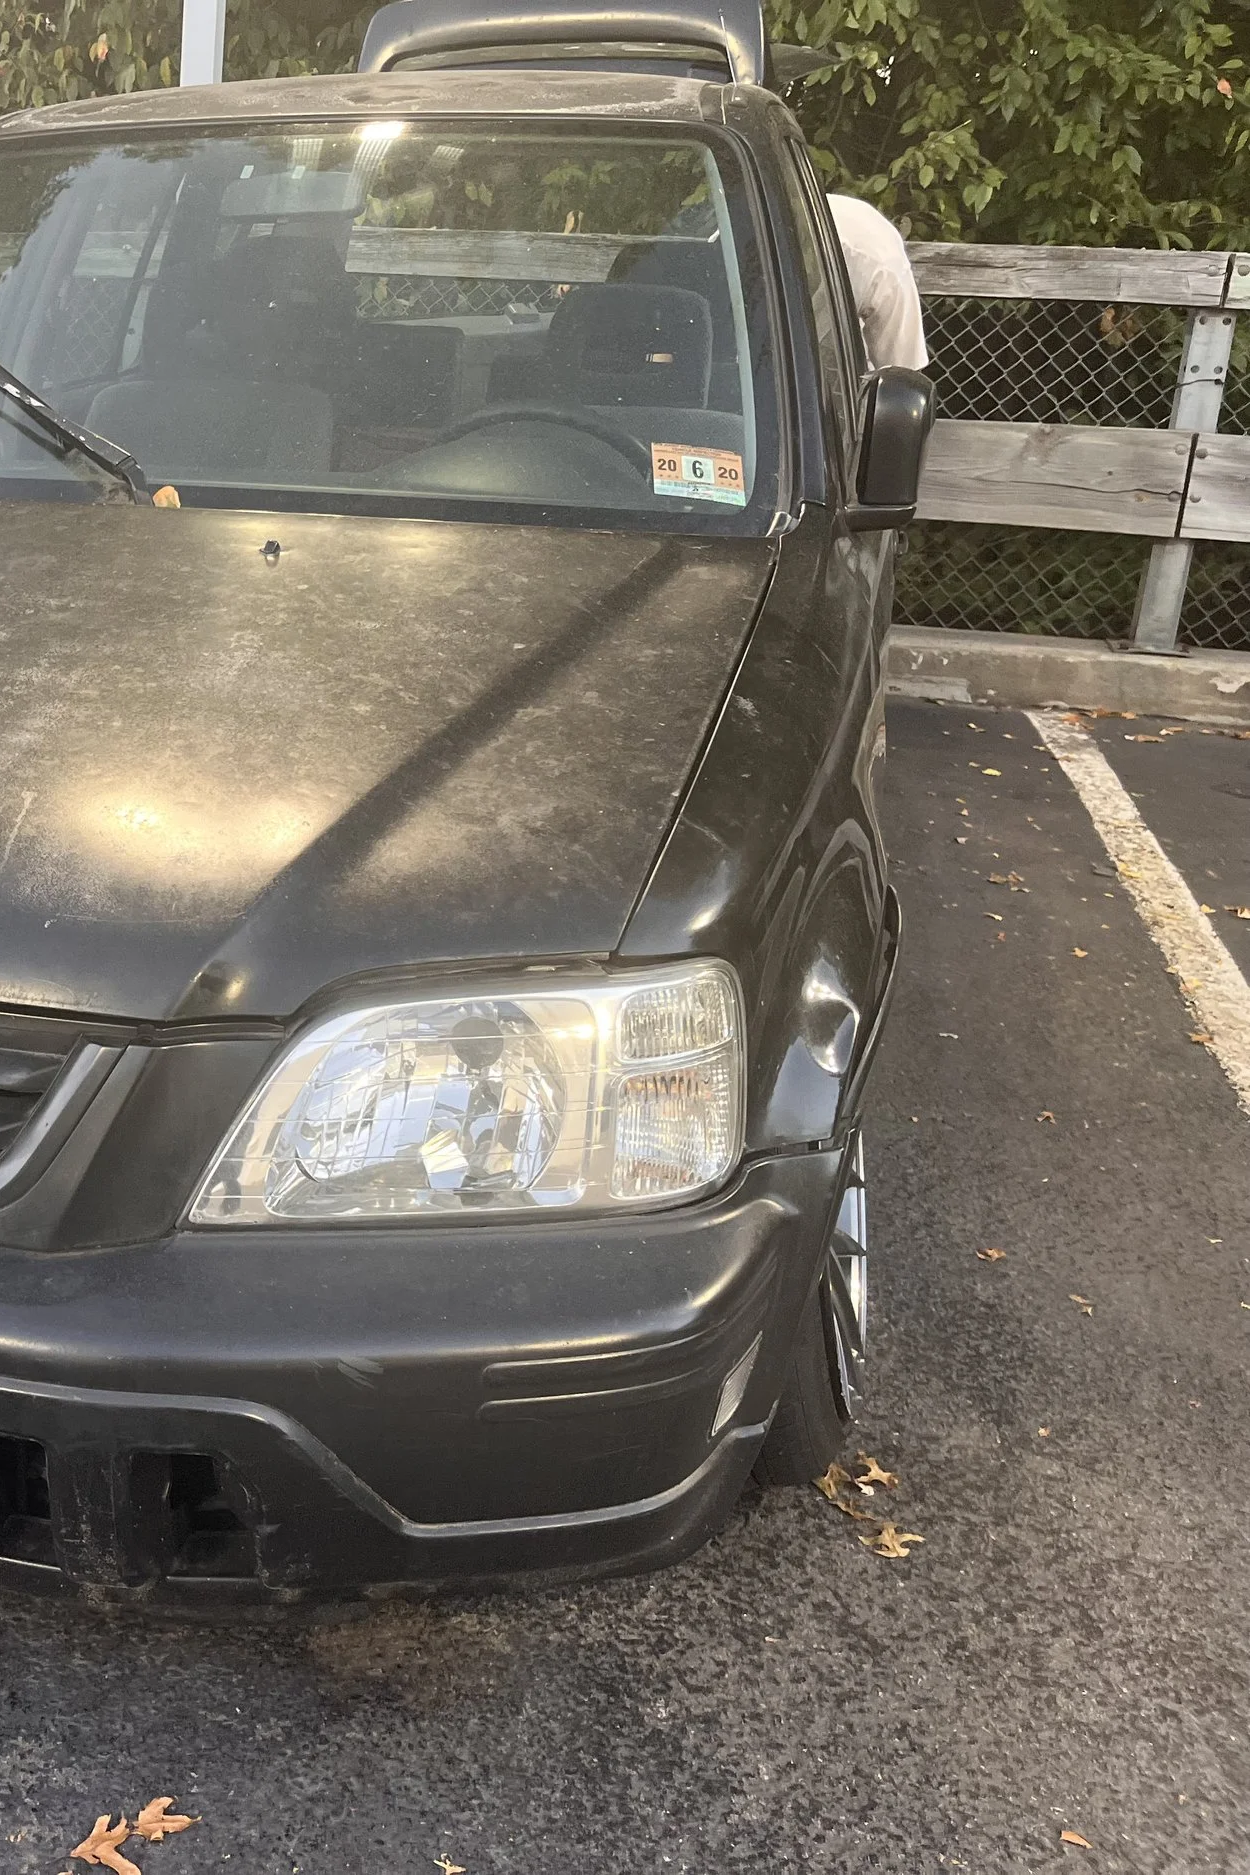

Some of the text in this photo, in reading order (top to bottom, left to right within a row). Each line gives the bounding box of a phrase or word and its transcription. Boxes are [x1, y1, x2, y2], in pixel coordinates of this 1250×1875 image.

[657, 458, 739, 481] 20 6 20
